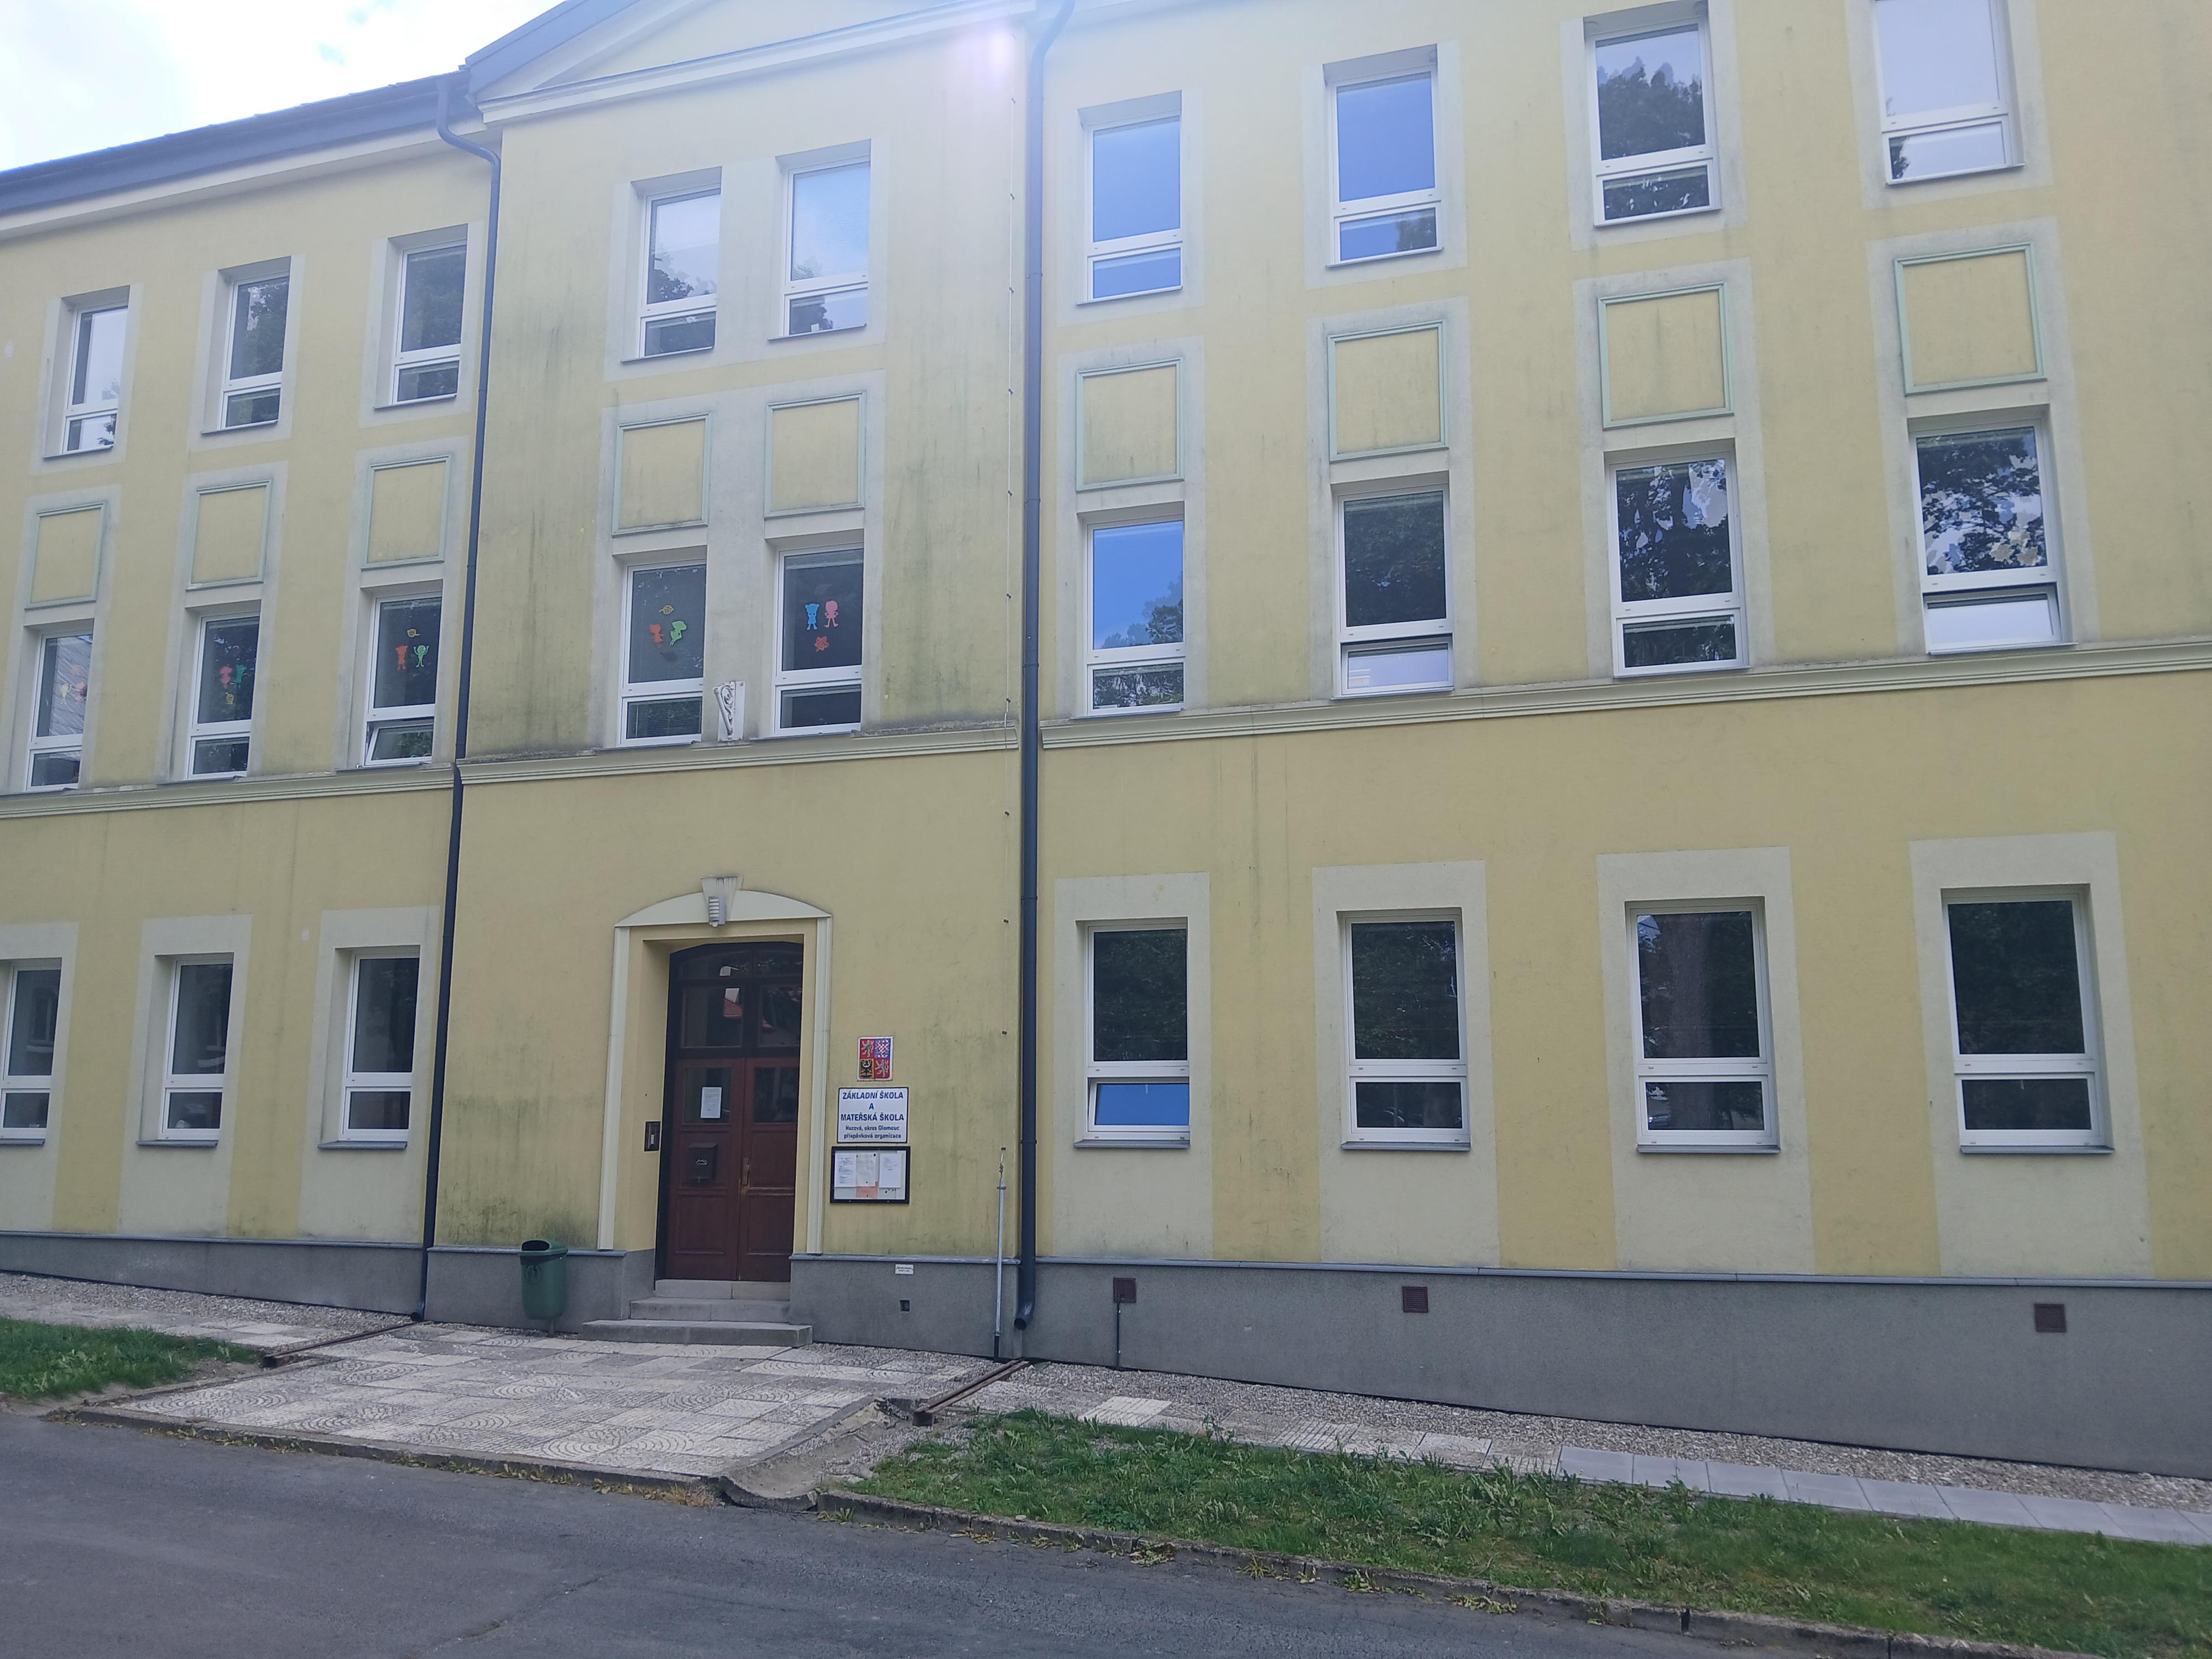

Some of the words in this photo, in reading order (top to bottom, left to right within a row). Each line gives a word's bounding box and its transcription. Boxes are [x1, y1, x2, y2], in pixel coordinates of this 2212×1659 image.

[843, 1091, 878, 1099] ZÁKLADNÍ
[879, 1091, 903, 1099] ŠKOLA
[841, 1112, 878, 1121] MATEŘSKÁ
[880, 1112, 904, 1120] ŠKOLA
